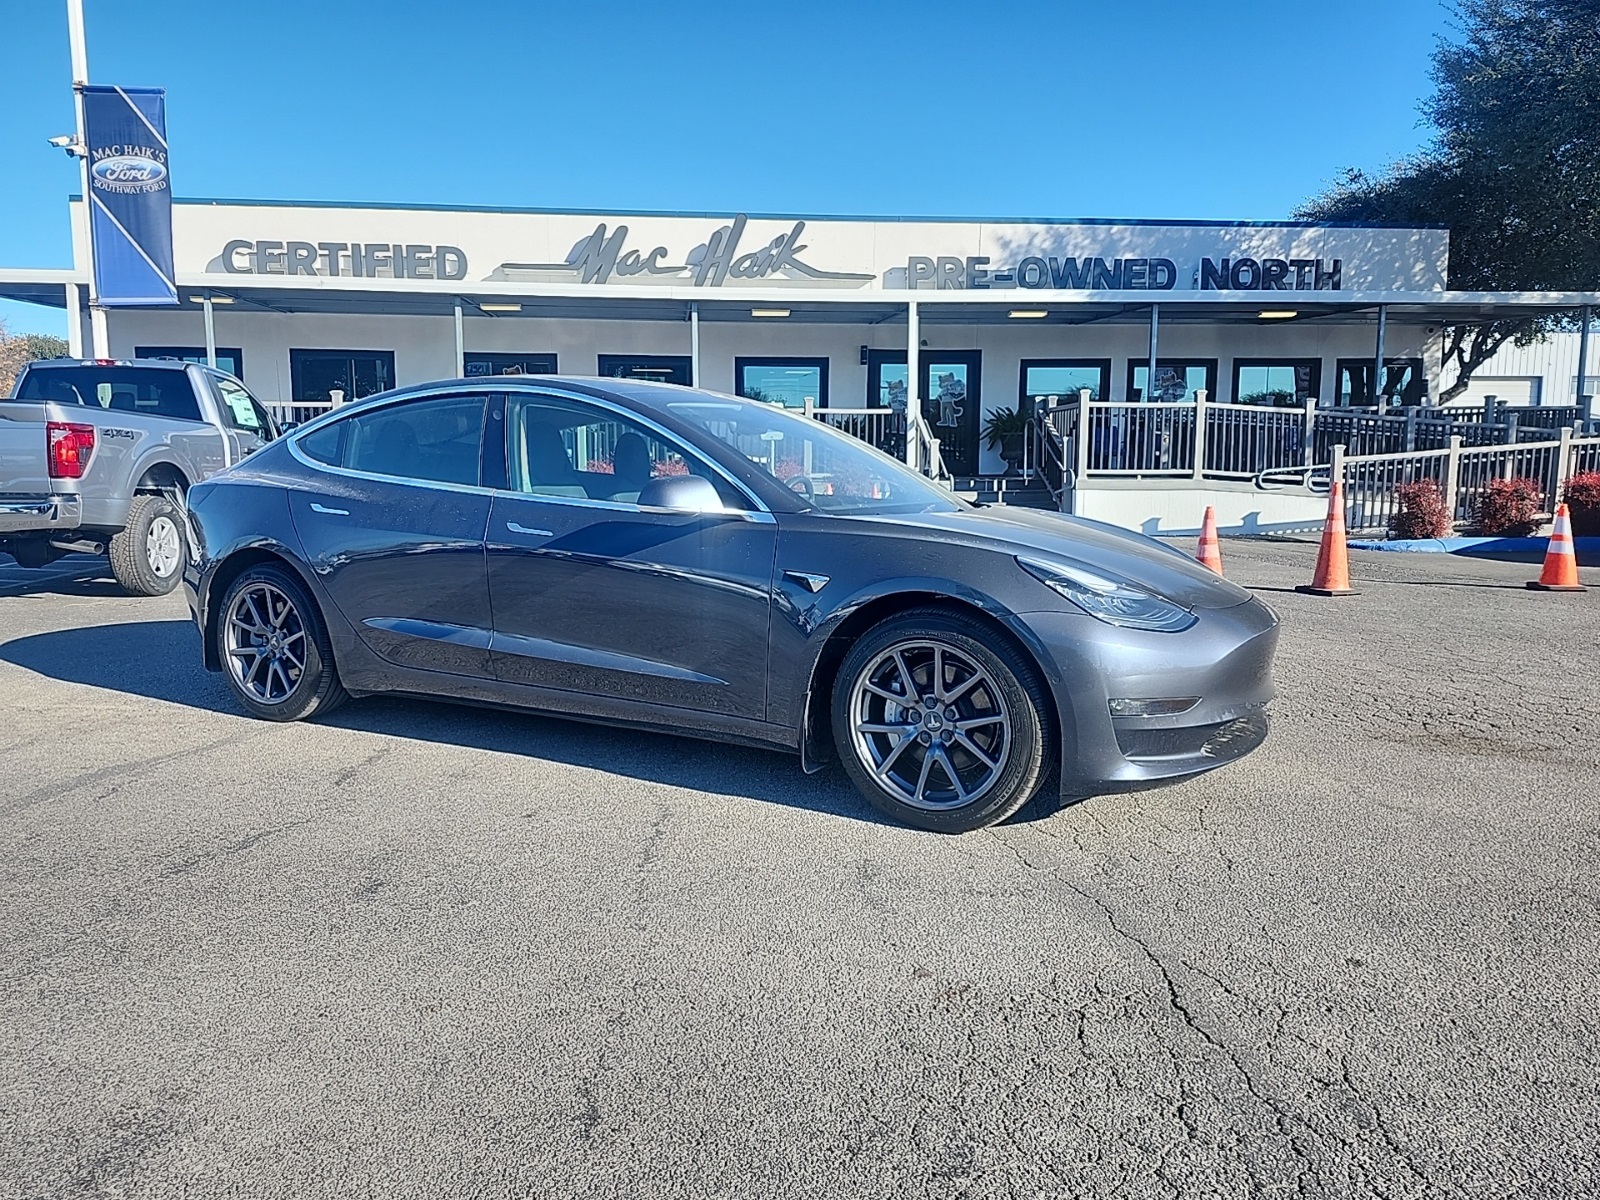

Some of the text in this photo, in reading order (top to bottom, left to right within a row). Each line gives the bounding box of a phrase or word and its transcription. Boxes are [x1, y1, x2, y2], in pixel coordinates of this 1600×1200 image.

[91, 145, 166, 163] MAC HAIK'S
[106, 162, 152, 180] Ford
[93, 180, 167, 195] SOUTHWAY FORD
[222, 239, 468, 281] CERTIFIED
[501, 213, 877, 288] Mac Haik
[908, 256, 1343, 291] PRE-OWNED NORTH
